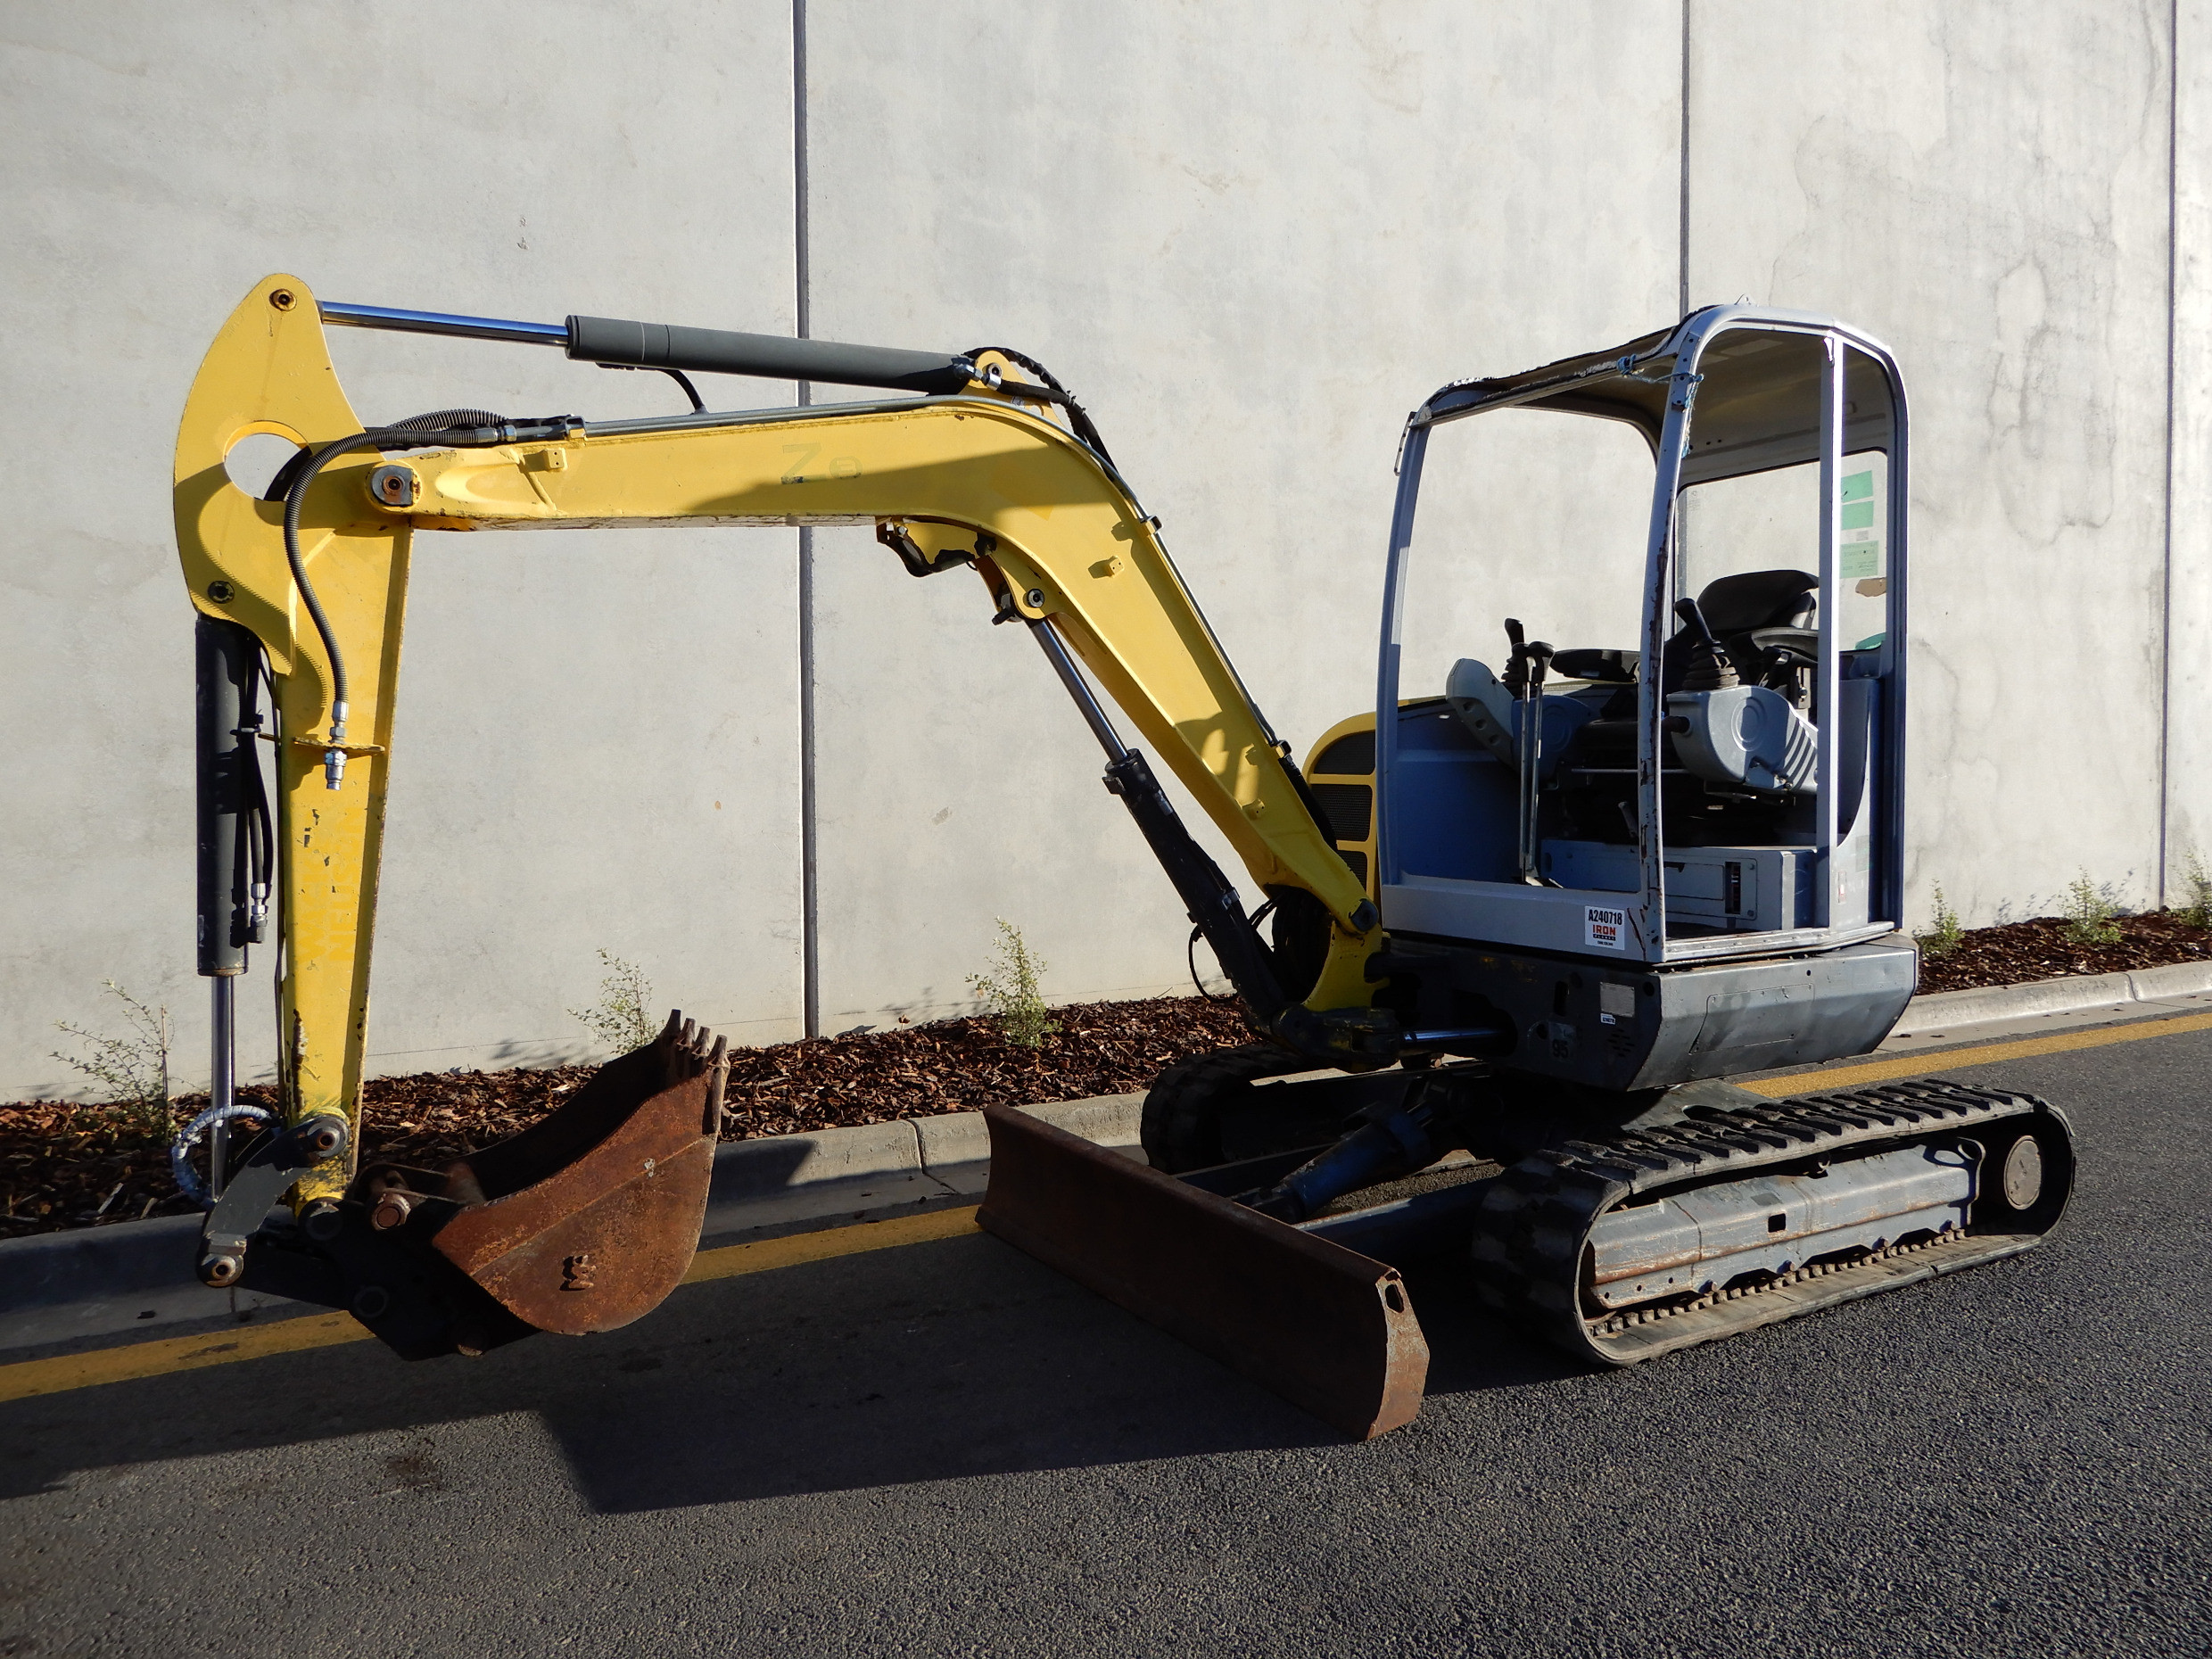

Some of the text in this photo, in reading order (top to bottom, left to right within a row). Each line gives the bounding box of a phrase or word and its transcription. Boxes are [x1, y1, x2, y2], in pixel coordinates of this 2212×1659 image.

[1589, 909, 1622, 925] A240718
[1593, 925, 1616, 934] IRON
[1552, 1038, 1569, 1056] 95
